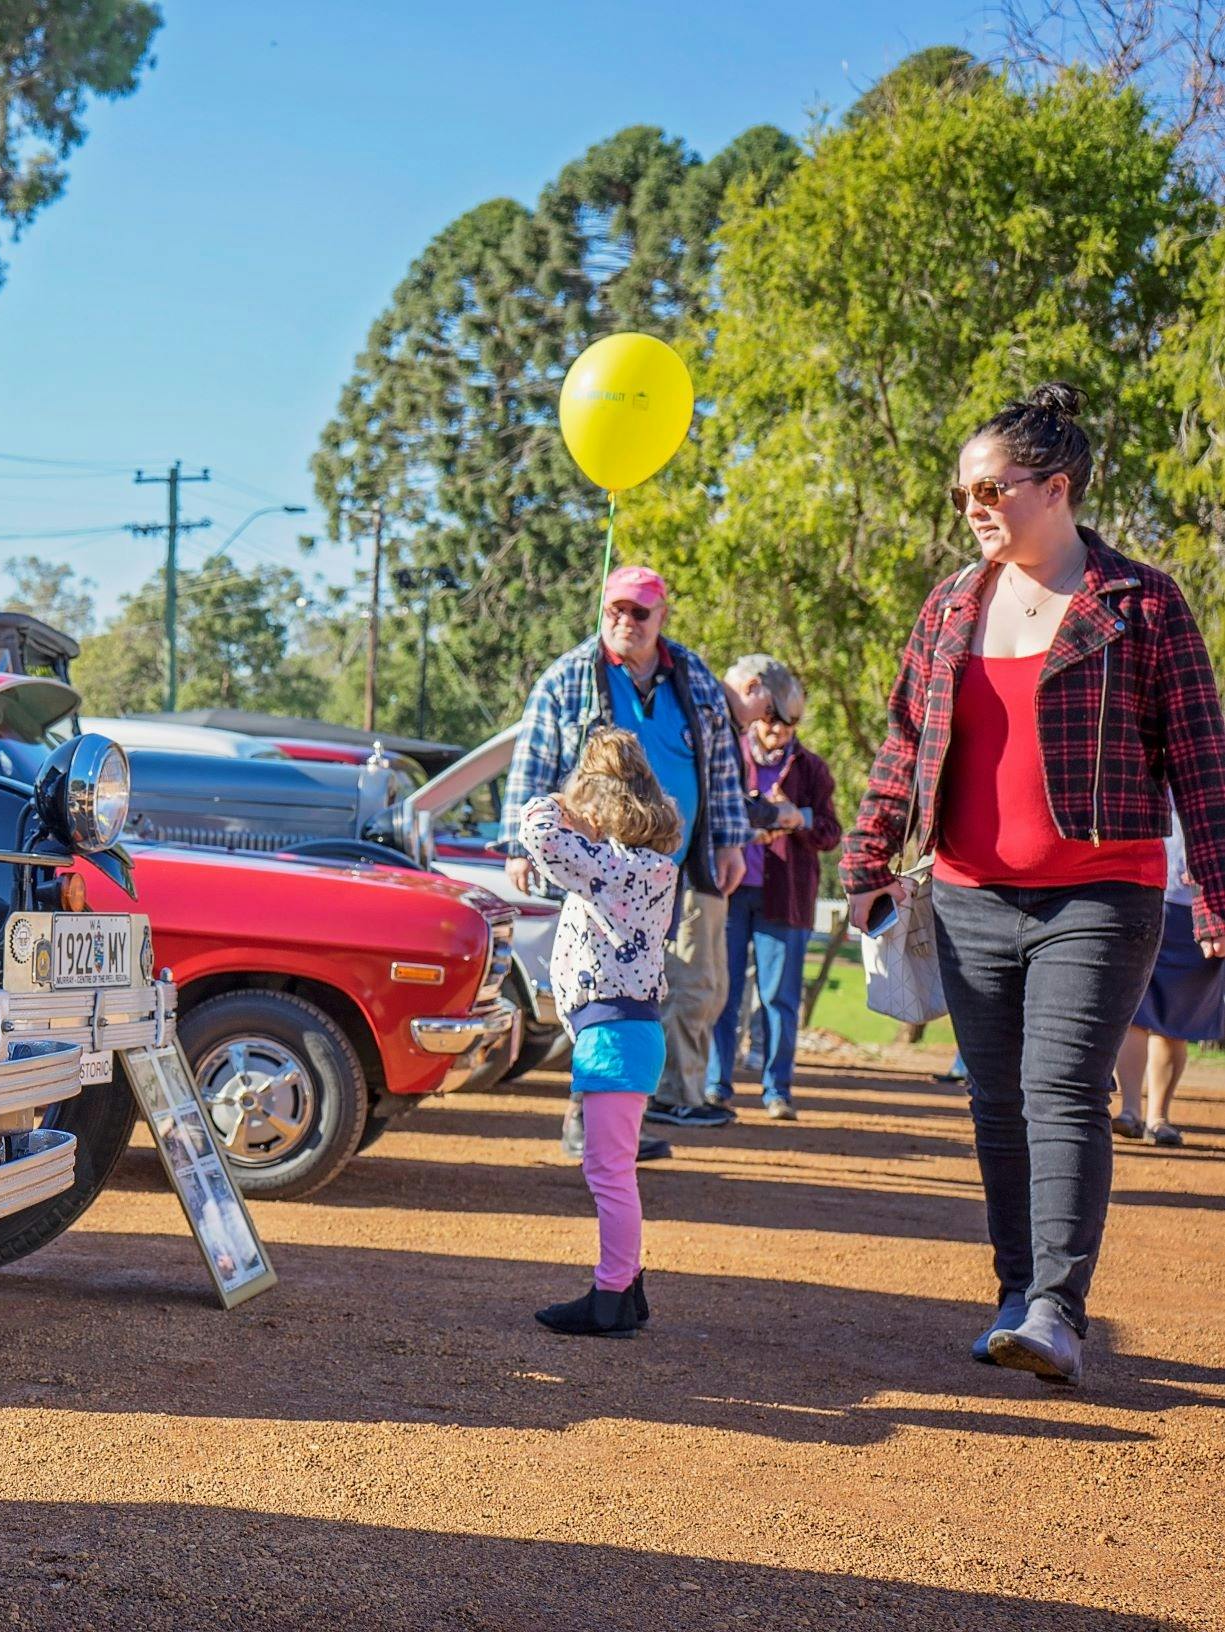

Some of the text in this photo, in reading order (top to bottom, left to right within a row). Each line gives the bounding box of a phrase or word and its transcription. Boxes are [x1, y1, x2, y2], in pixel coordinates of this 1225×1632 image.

[90, 920, 101, 931] WA
[57, 932, 93, 976] 1922
[108, 931, 127, 974] MY
